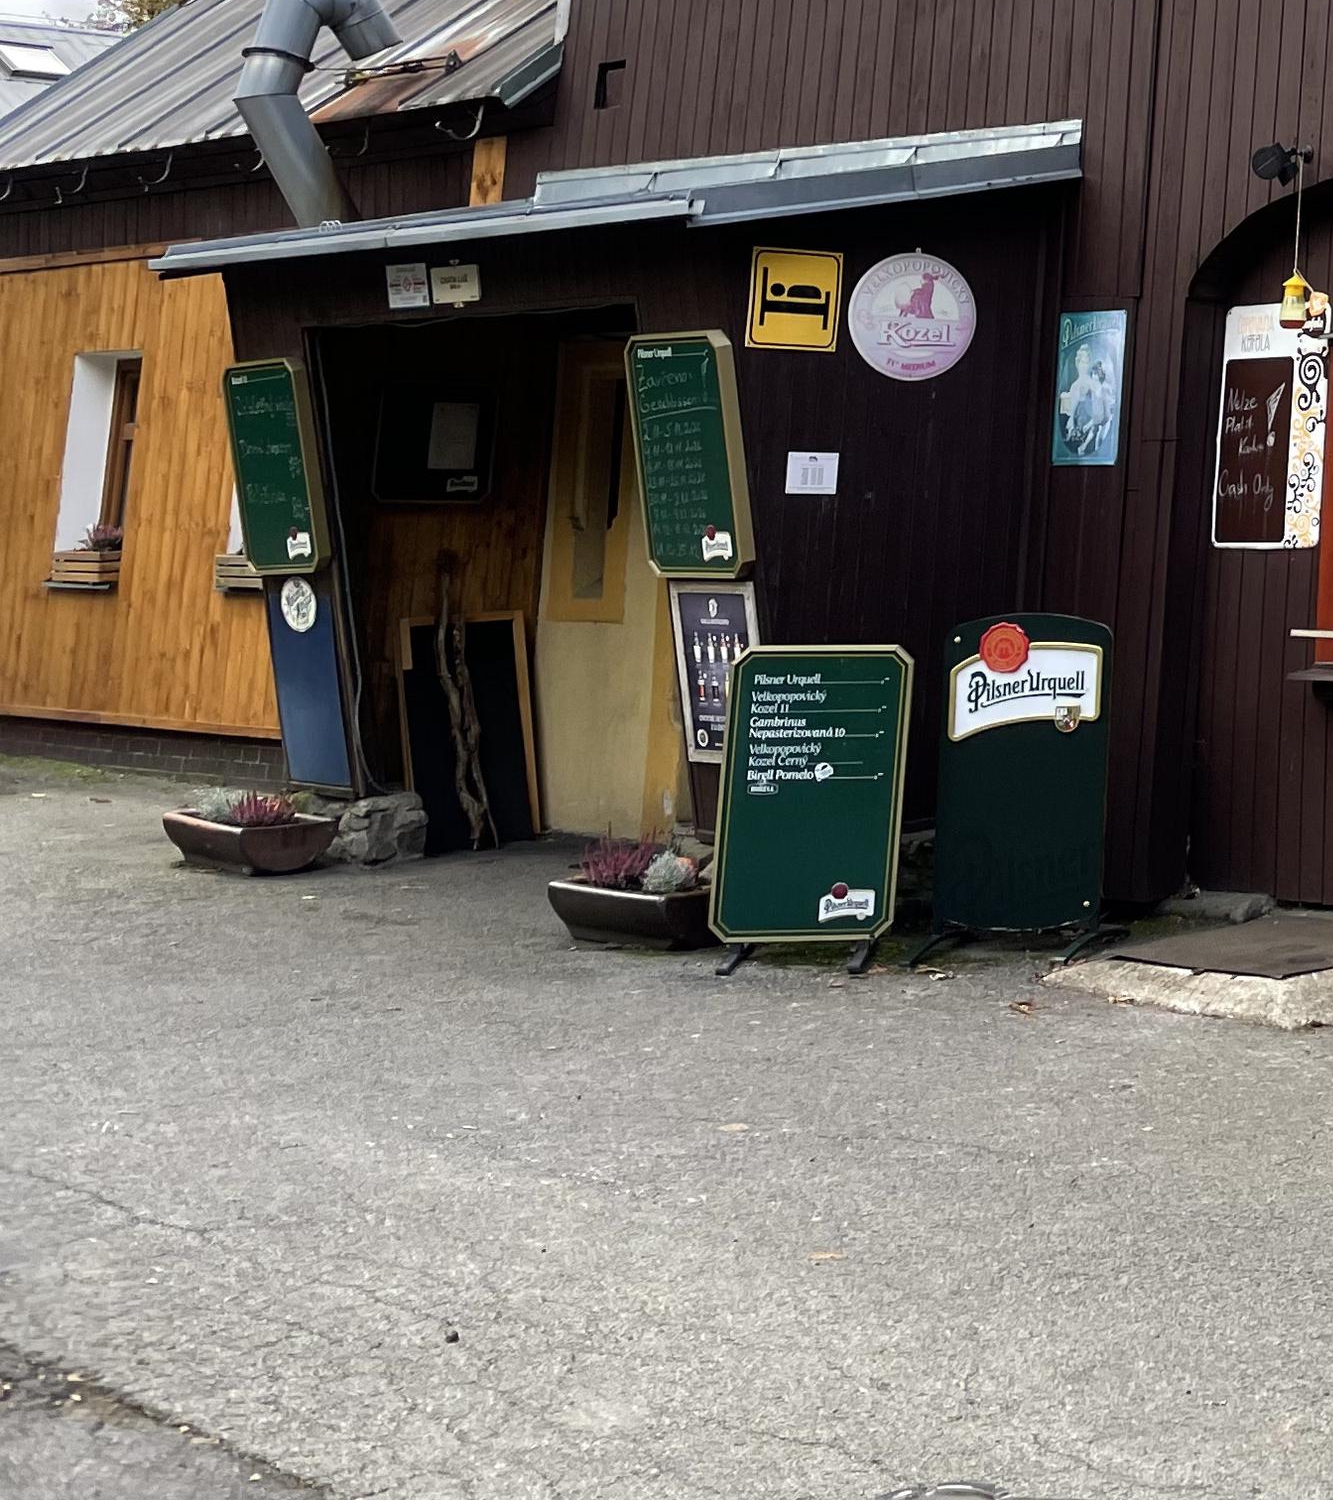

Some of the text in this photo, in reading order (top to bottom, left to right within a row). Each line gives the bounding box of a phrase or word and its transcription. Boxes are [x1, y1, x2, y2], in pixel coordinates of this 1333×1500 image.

[877, 321, 956, 348] Kozel
[1227, 387, 1258, 412] Nelze
[1219, 468, 1274, 512] Cash Only
[754, 673, 821, 687] Pilsner Urquell
[751, 689, 828, 704] Velkopopovický
[967, 668, 1086, 714] Pilsner Urquell
[750, 703, 790, 714] Kozel 11
[749, 716, 807, 728] Gambrinus
[749, 726, 846, 740] Nepasterizovaná 10
[749, 742, 822, 757] Velkopopovický
[748, 754, 809, 769] Kozel Černý
[775, 768, 815, 781] Pomelo
